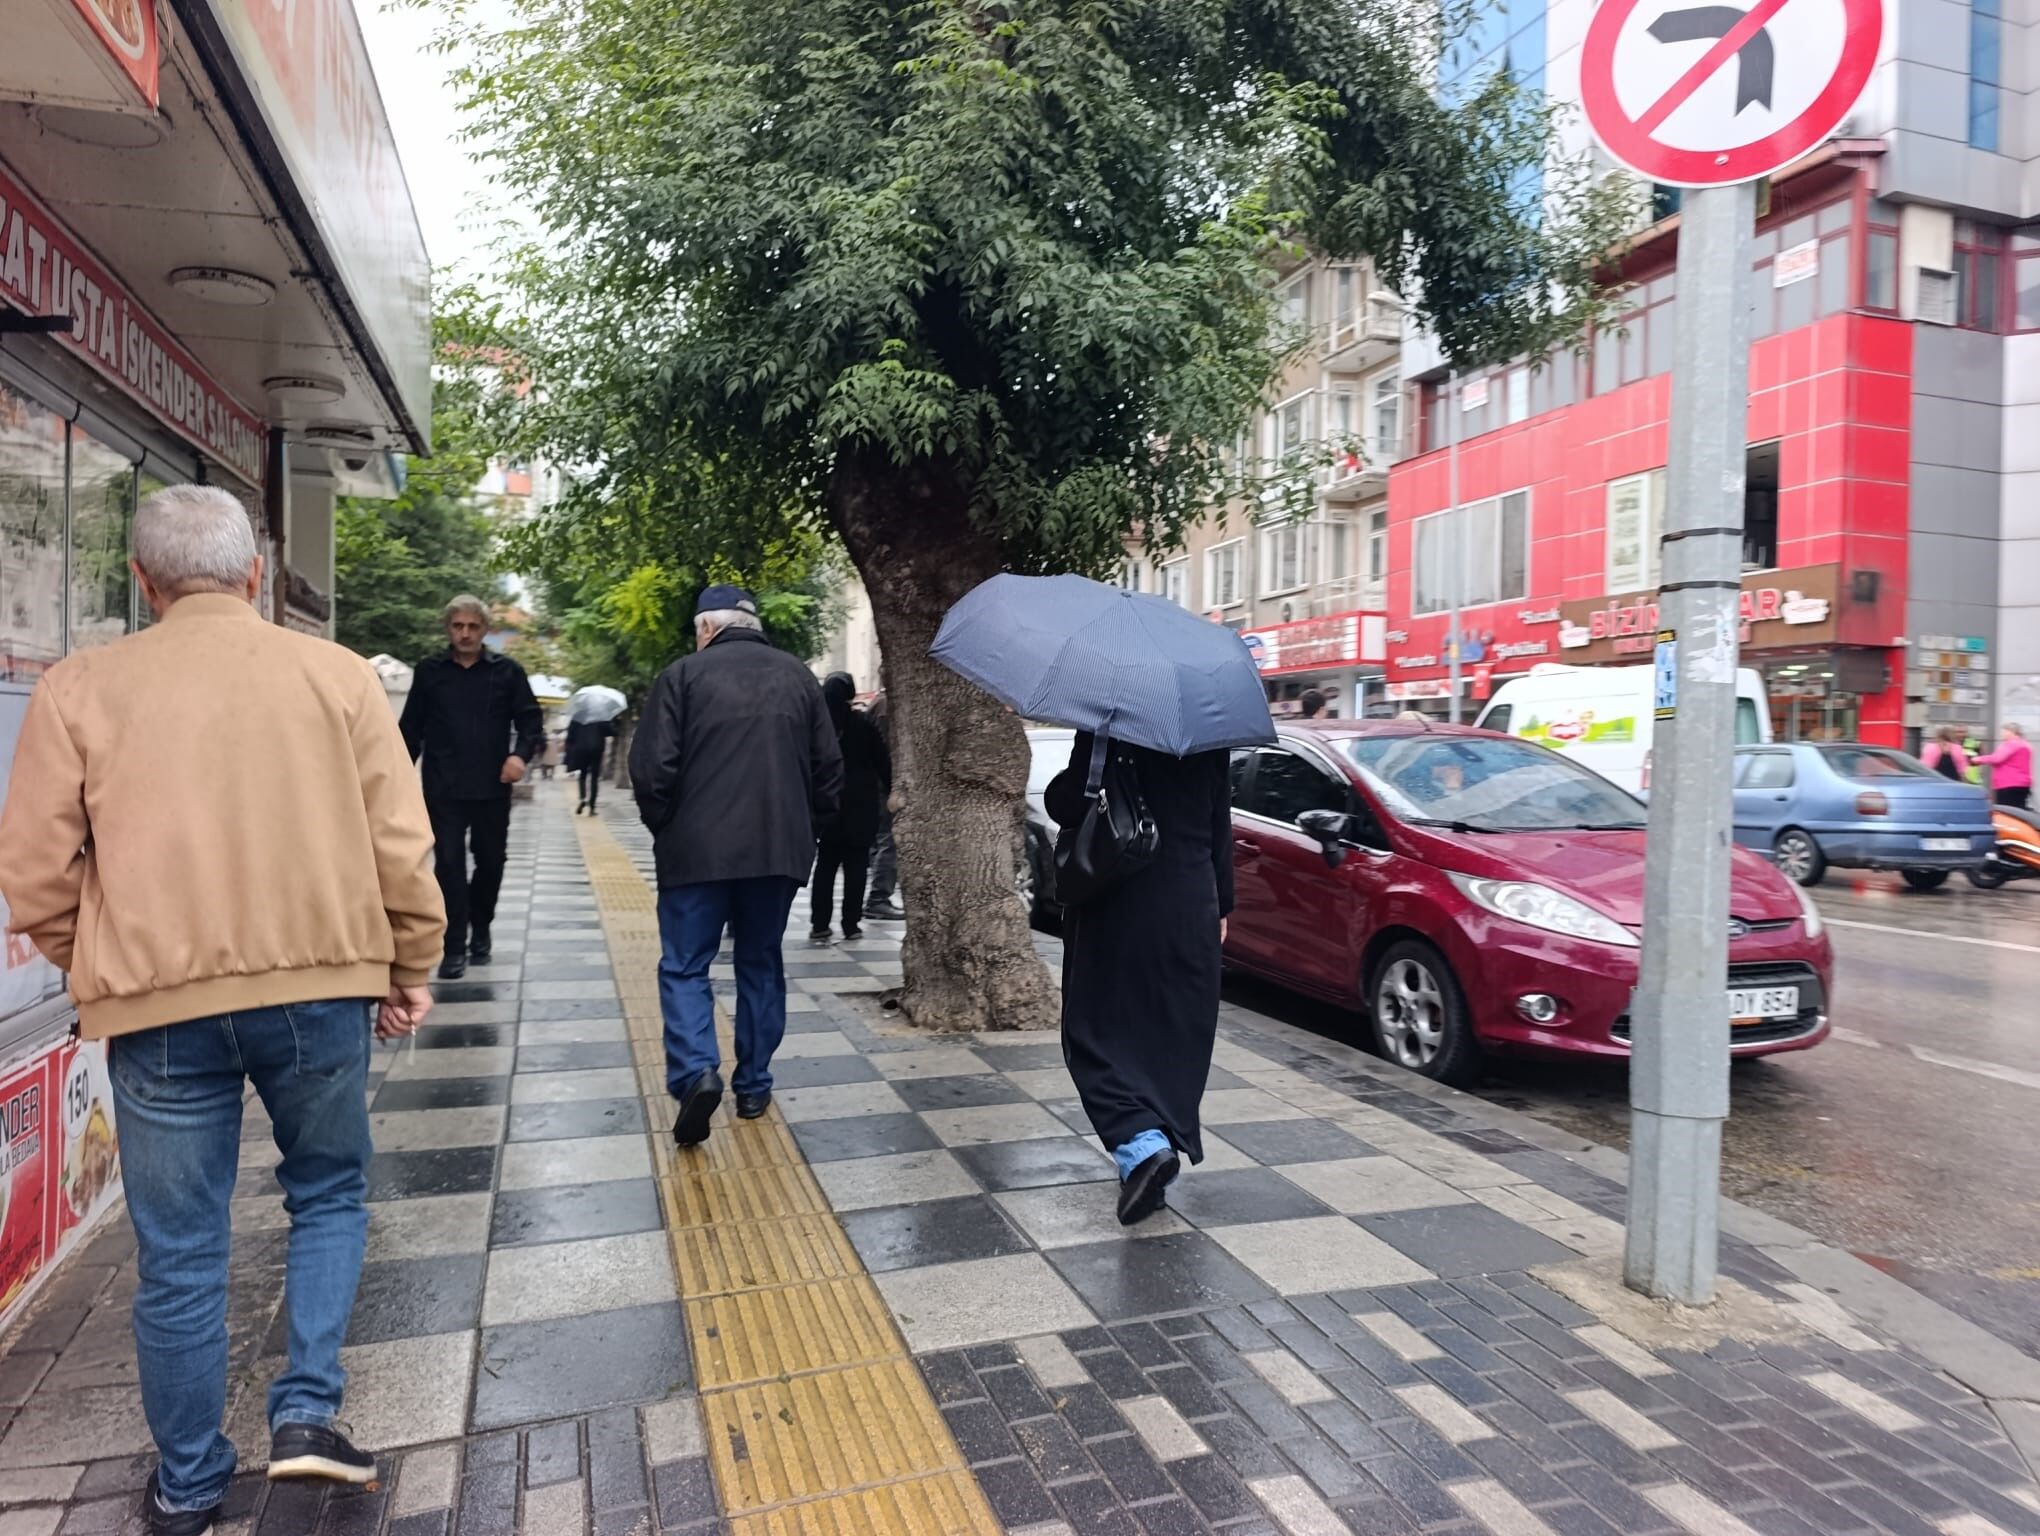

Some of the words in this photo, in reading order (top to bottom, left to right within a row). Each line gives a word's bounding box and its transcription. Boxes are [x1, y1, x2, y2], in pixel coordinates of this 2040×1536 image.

[0, 195, 46, 309] AT
[52, 248, 117, 368] USTA
[121, 299, 207, 440] İSKENDER
[207, 395, 261, 480] SALONU
[68, 1069, 88, 1124] 150
